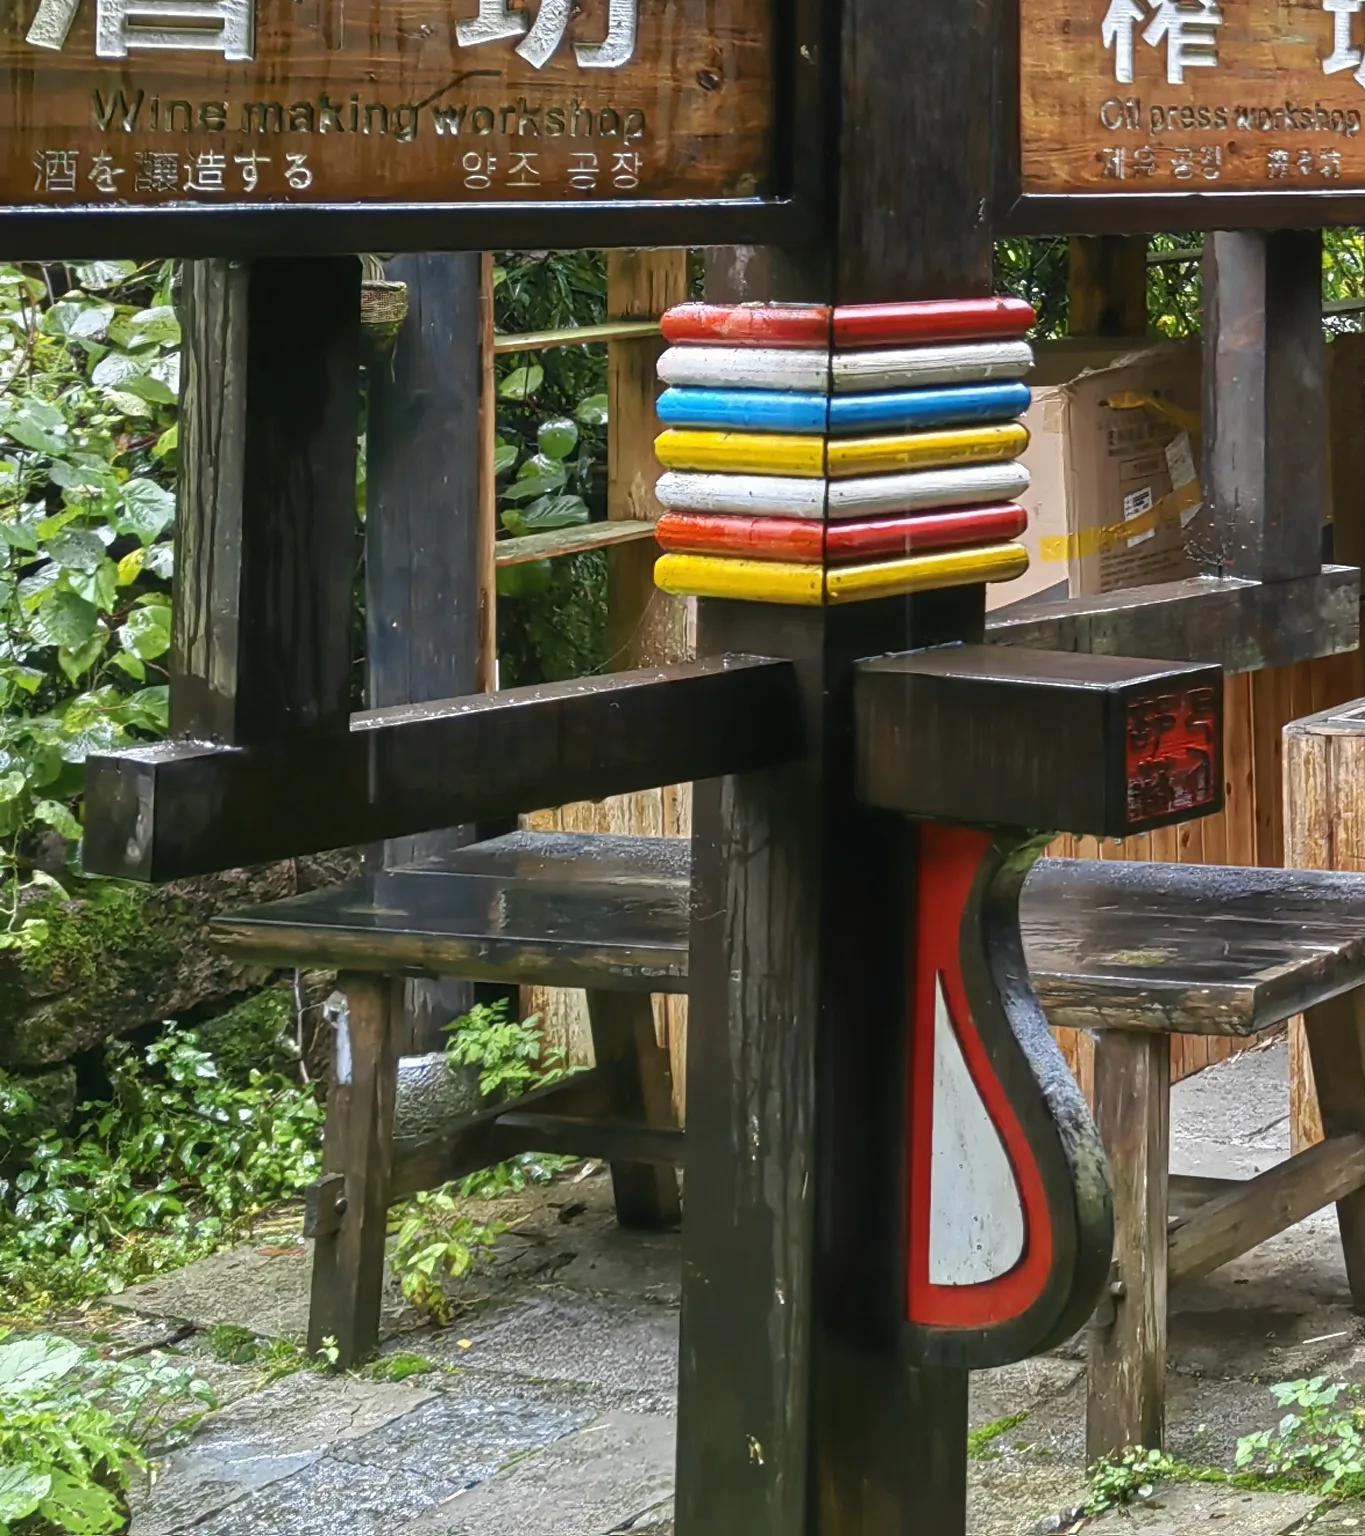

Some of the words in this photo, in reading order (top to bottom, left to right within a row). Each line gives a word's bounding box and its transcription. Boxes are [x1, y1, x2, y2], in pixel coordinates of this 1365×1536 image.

[91, 88, 228, 133] Wine
[239, 92, 419, 143] making
[431, 96, 648, 146] workshop
[1101, 96, 1141, 130] Oil
[1150, 104, 1229, 136] press
[1234, 101, 1362, 138] workshop
[463, 151, 541, 190] 양조
[567, 151, 643, 190] 공장
